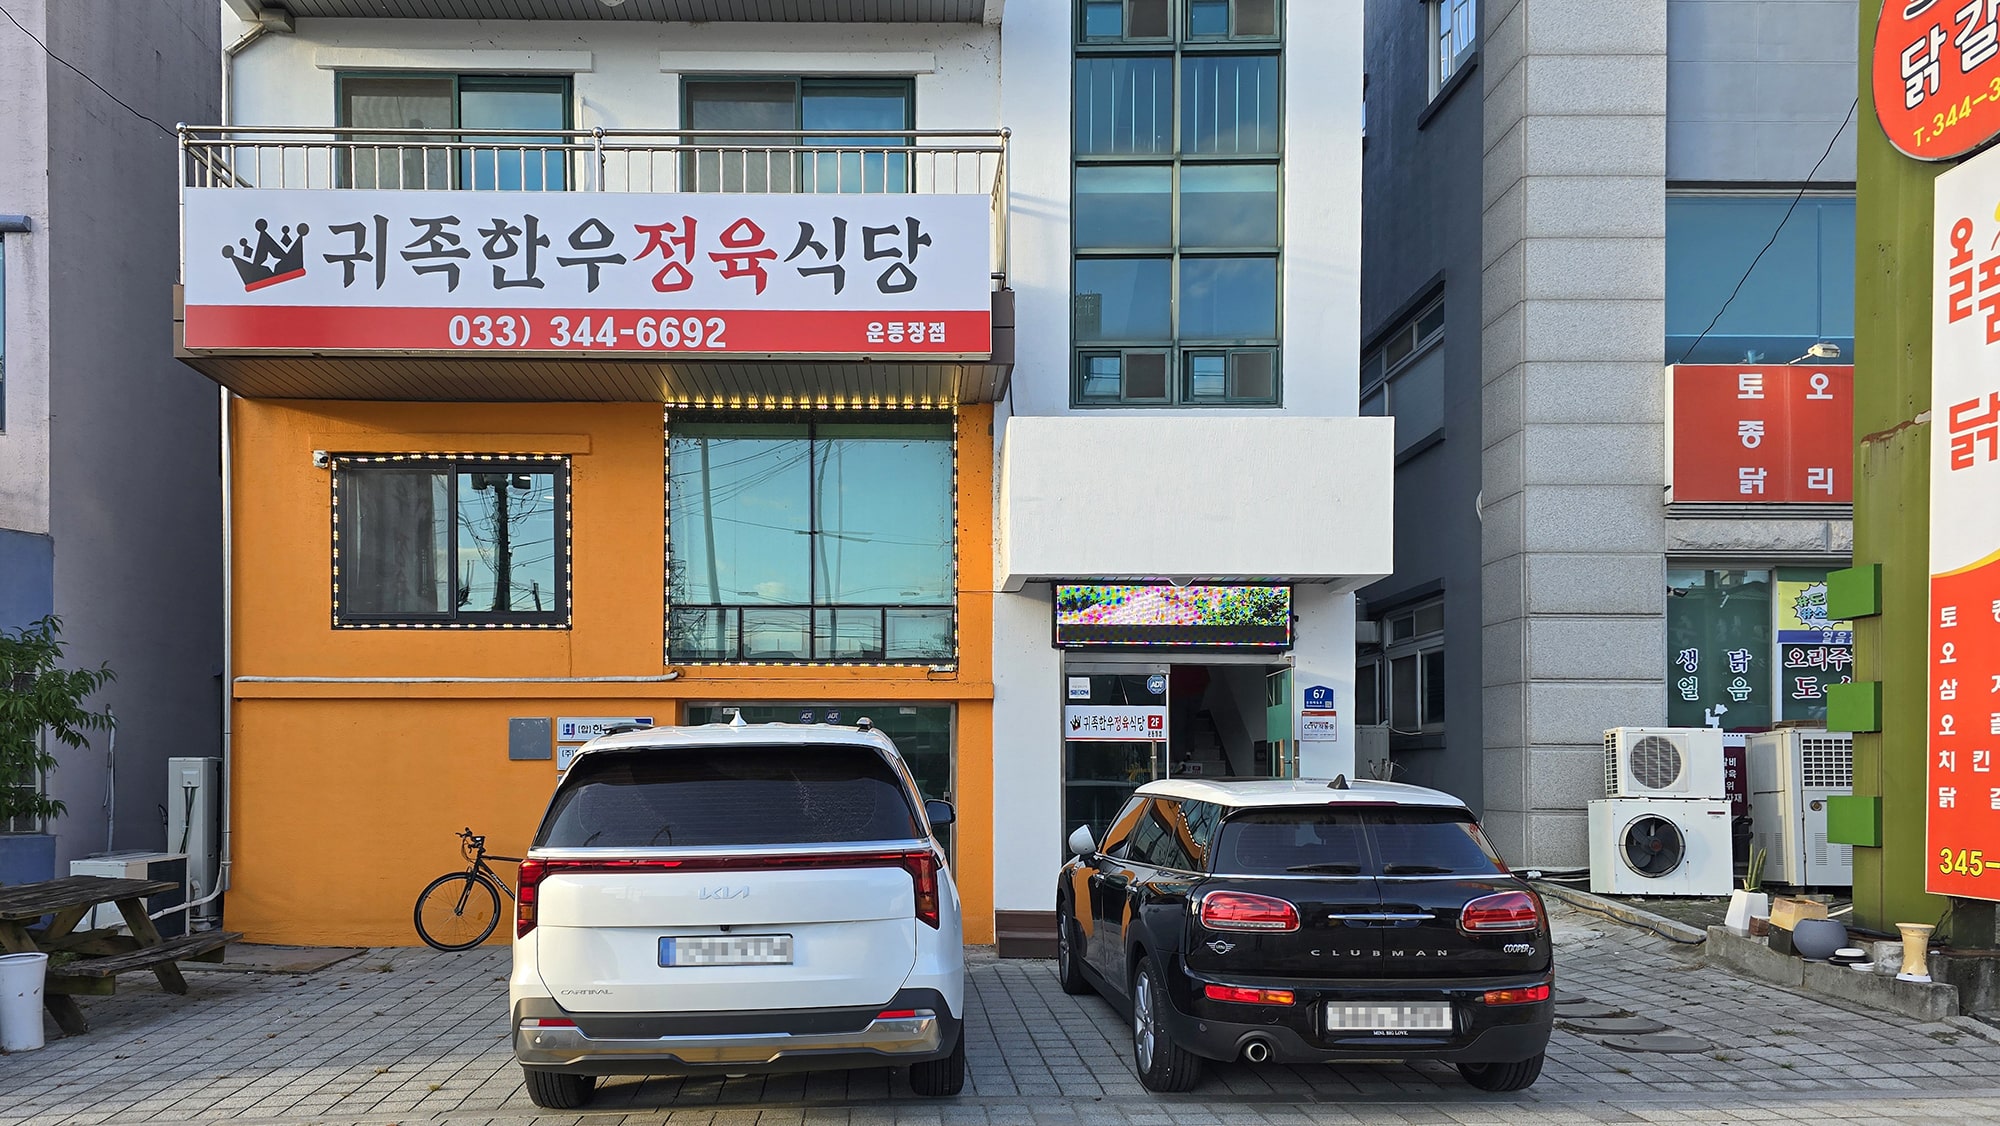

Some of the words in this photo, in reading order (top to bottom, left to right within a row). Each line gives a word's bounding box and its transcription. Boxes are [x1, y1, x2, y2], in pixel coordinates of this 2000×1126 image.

[322, 213, 932, 296] 귀족한우정육식당
[448, 315, 531, 347] 033)
[549, 316, 727, 349] 344-6692
[866, 321, 945, 343] 운동장점
[1313, 689, 1325, 699] 67
[698, 886, 750, 900] KIA
